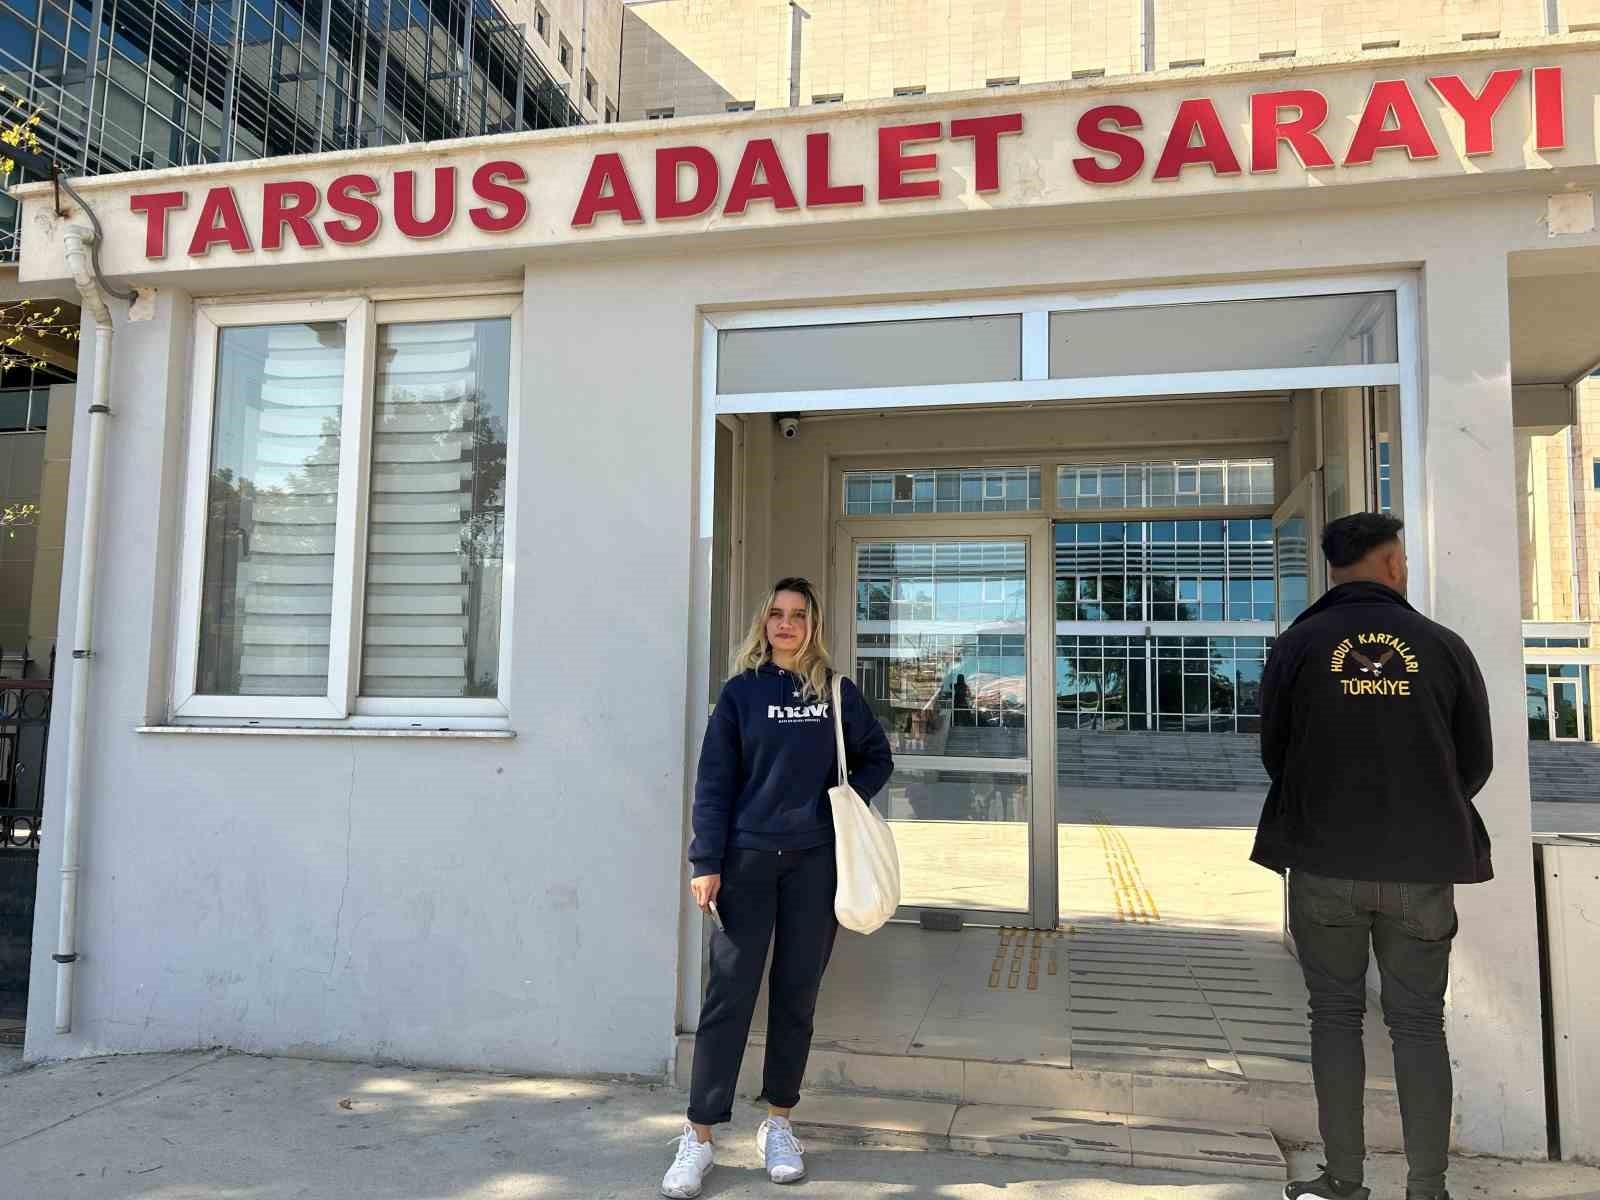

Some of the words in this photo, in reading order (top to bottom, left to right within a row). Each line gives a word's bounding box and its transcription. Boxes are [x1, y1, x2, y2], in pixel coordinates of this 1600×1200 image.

[130, 160, 528, 259] TARSUS
[571, 112, 1023, 226] ADALET
[1073, 65, 1566, 184] SARAYI
[1330, 638, 1353, 672] HUDUT
[1358, 632, 1419, 673] KARTALLARI
[1340, 677, 1411, 696] TÜRKİYE
